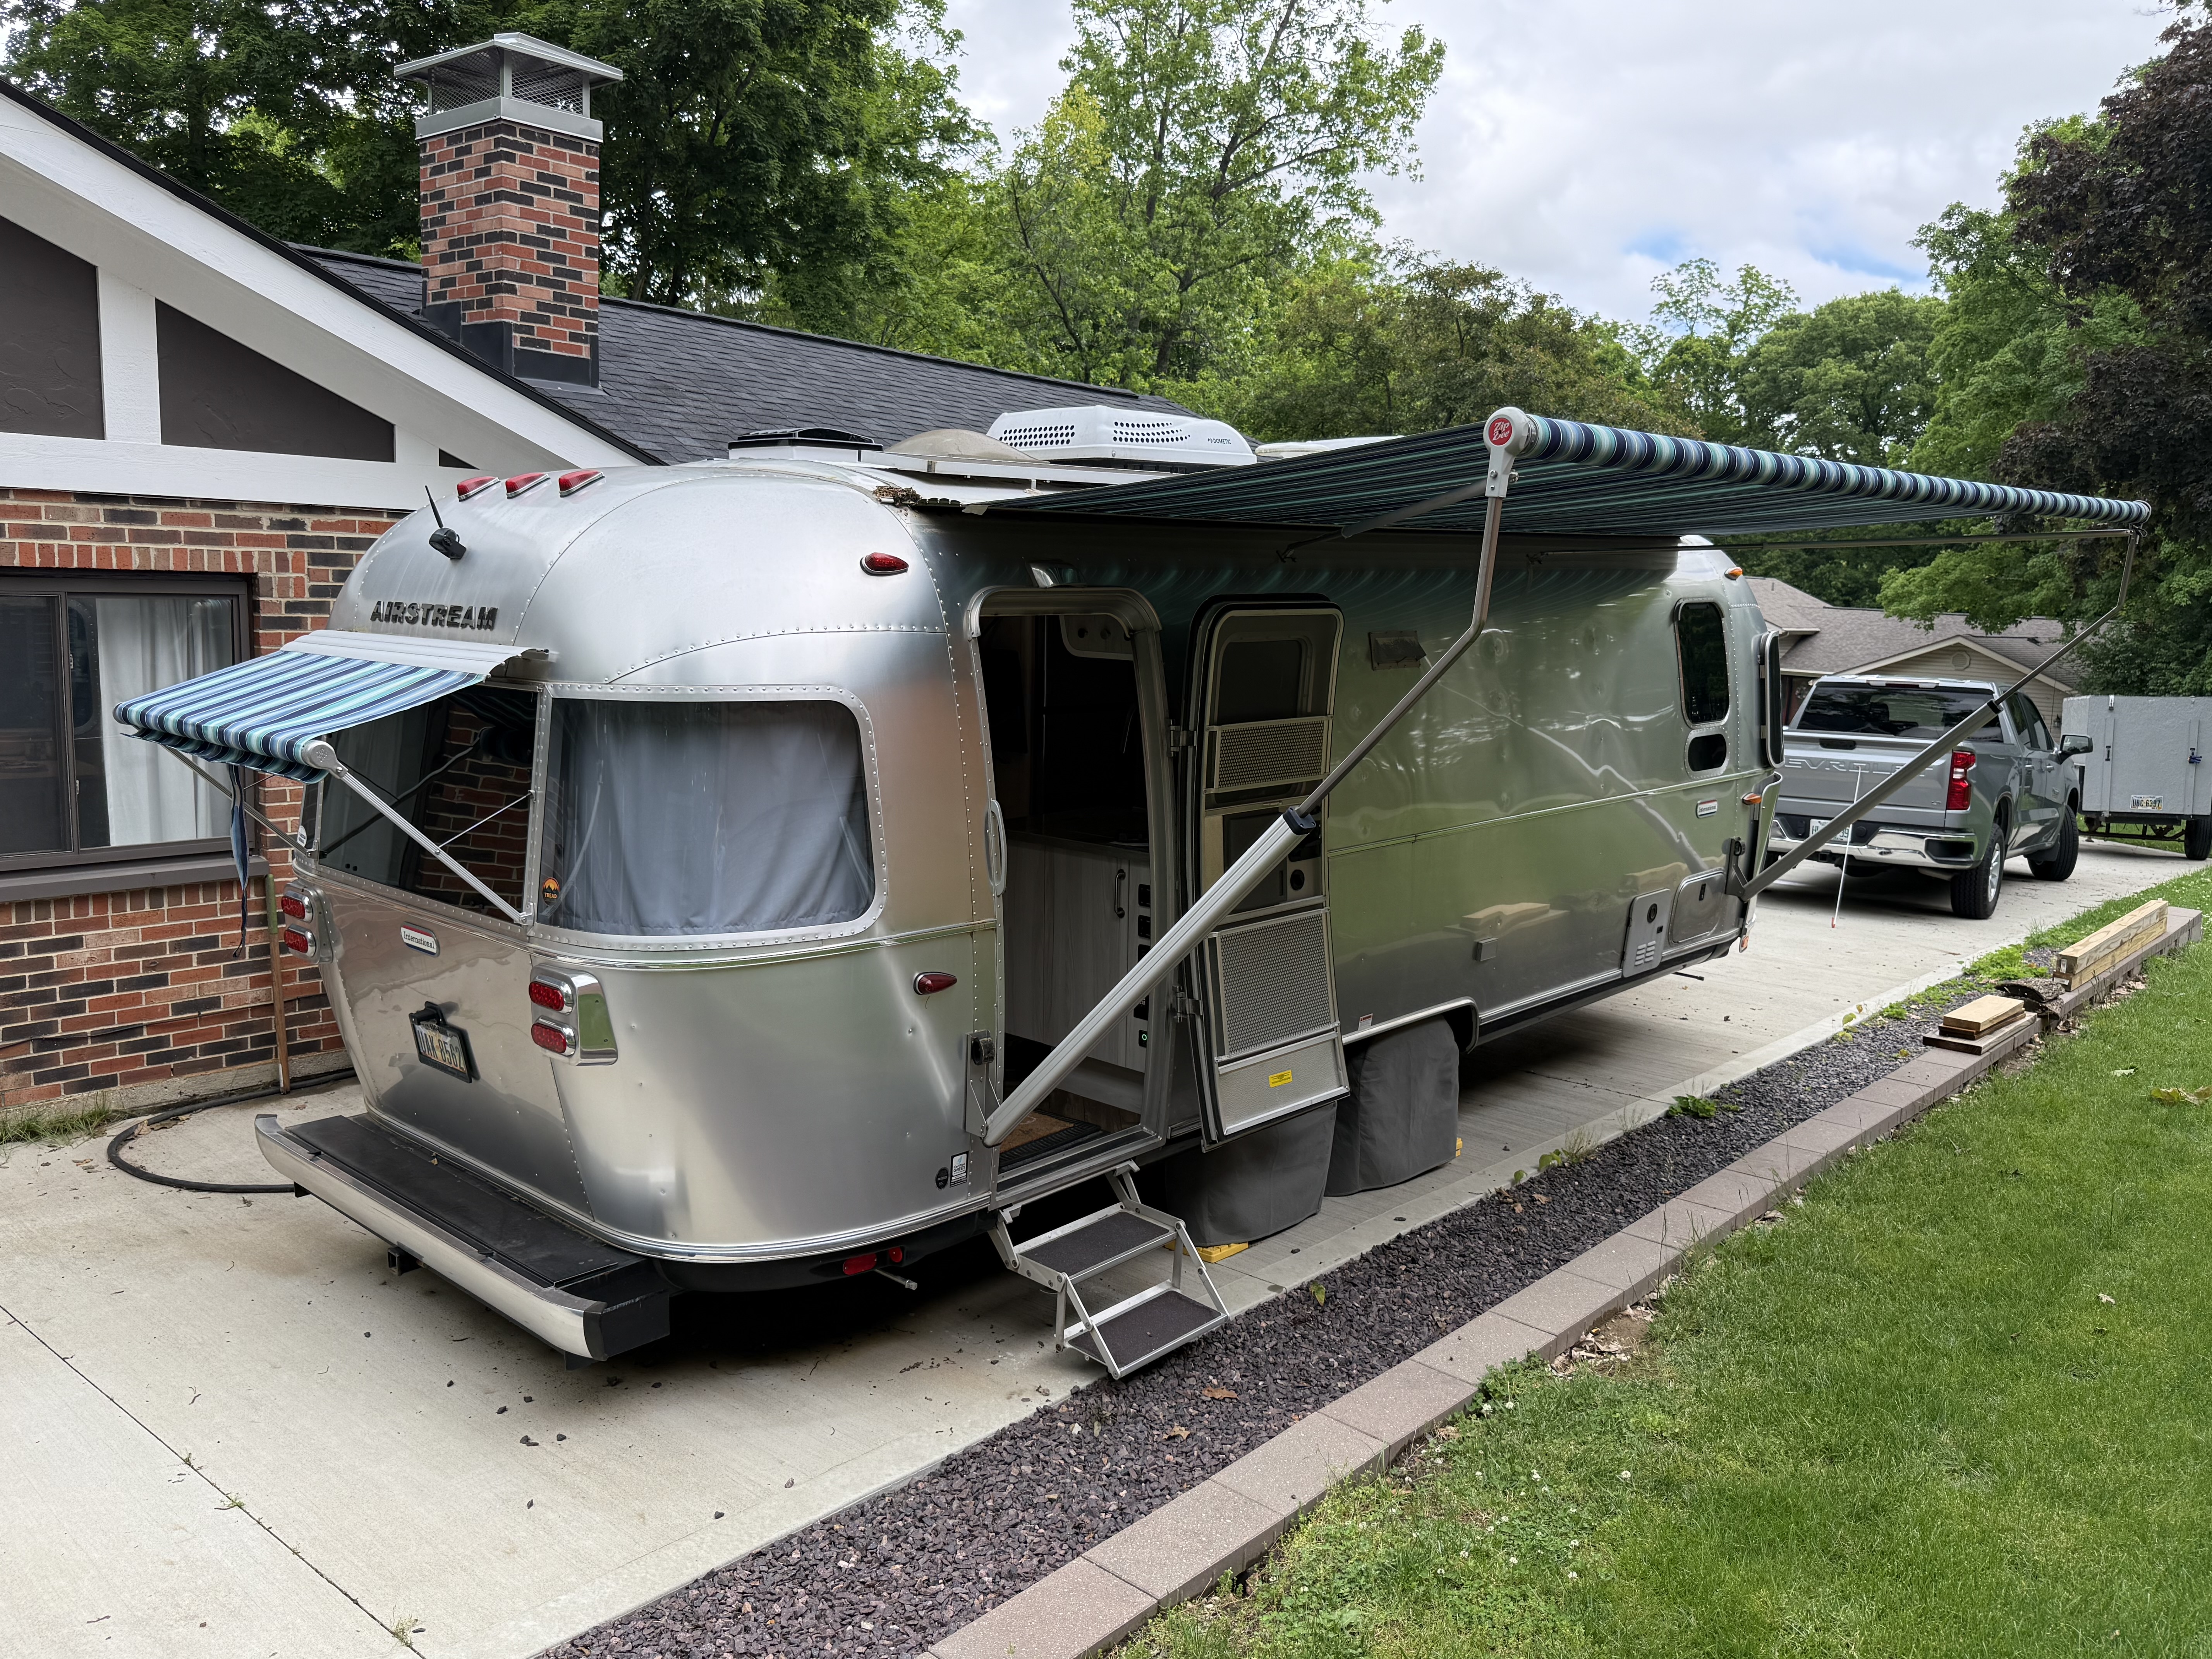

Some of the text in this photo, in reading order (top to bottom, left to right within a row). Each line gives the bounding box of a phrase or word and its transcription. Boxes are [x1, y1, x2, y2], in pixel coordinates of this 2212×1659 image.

[370, 601, 499, 631] AIRSTREAM
[2133, 799, 2161, 807] UBC 6397
[404, 931, 435, 949] International
[438, 1039, 464, 1070] 8562
